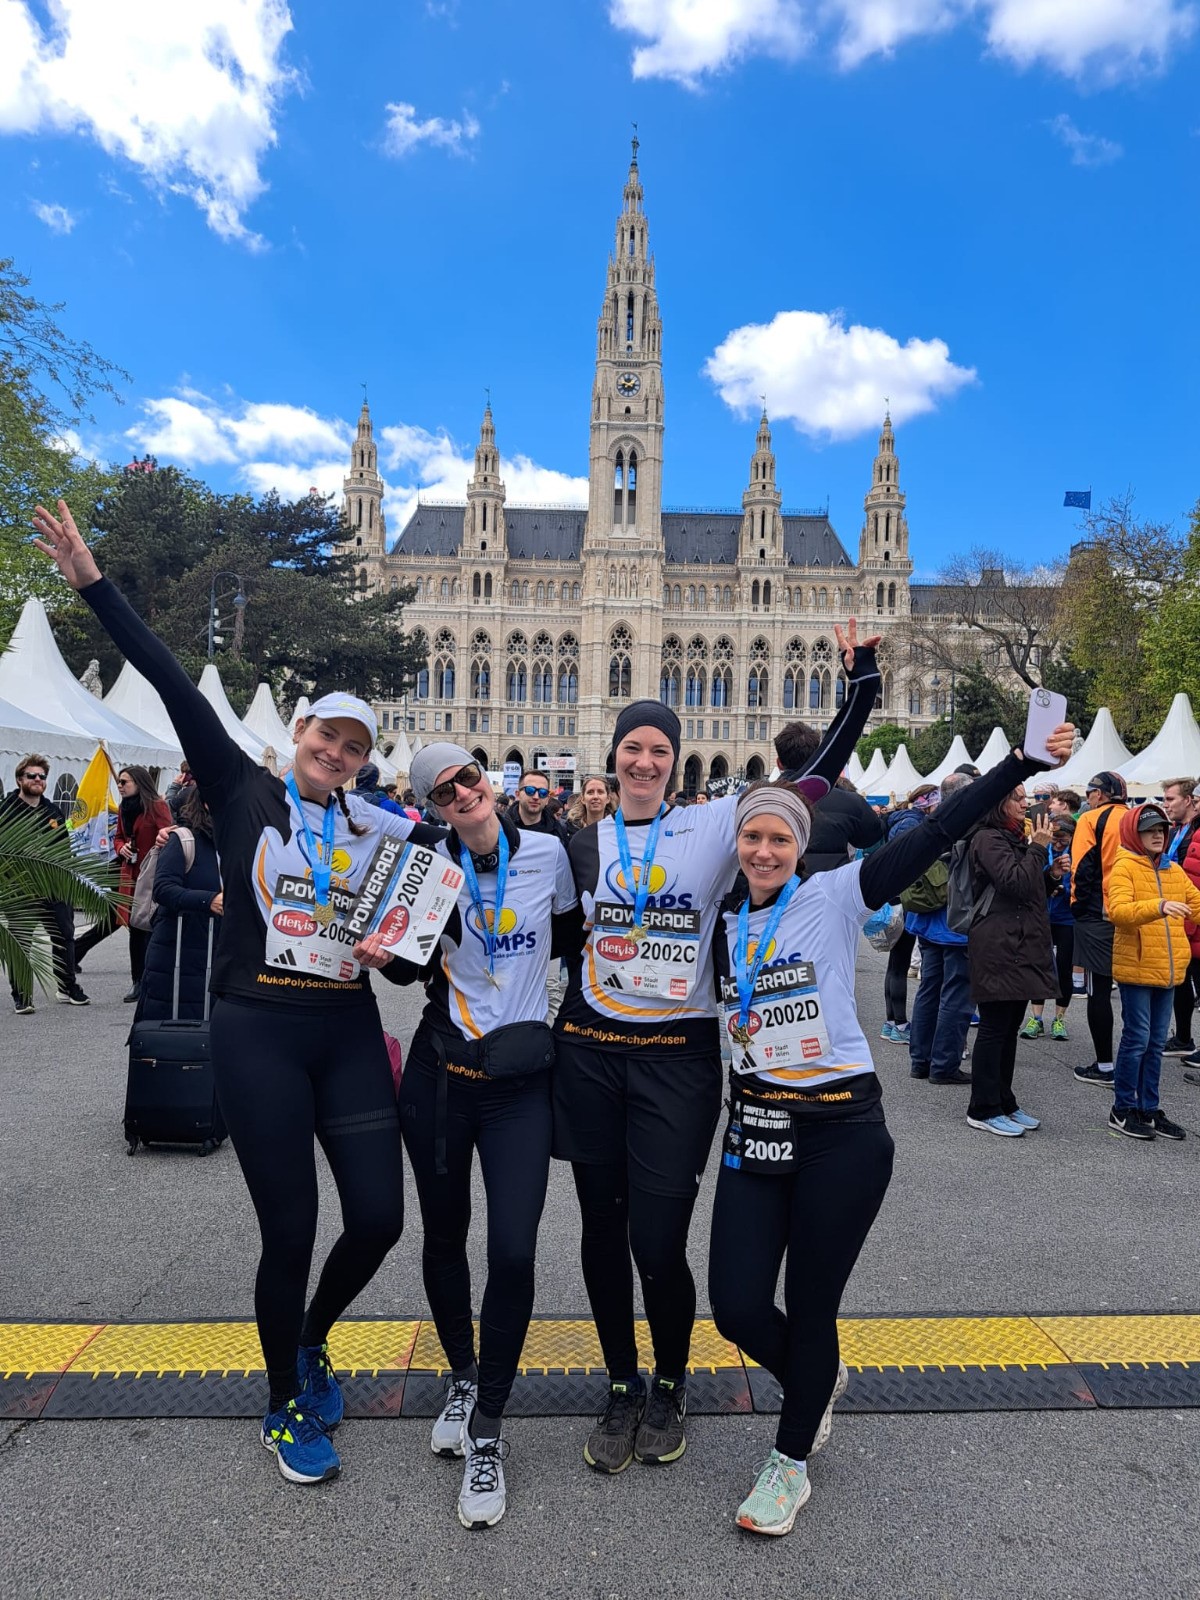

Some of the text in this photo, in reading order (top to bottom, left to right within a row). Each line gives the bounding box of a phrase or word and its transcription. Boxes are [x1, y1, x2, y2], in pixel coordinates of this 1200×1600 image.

[708, 780, 727, 791] ROCK
[348, 841, 401, 934] POWERADE
[397, 850, 434, 907] 2002B
[277, 913, 315, 932] Hervis
[383, 909, 406, 944] Hervis
[601, 941, 635, 956] Hervis
[640, 941, 696, 963] 2002C
[763, 999, 819, 1028] 2002D
[758, 1118, 791, 1130] HISTORY!
[745, 1139, 794, 1162] 2002
